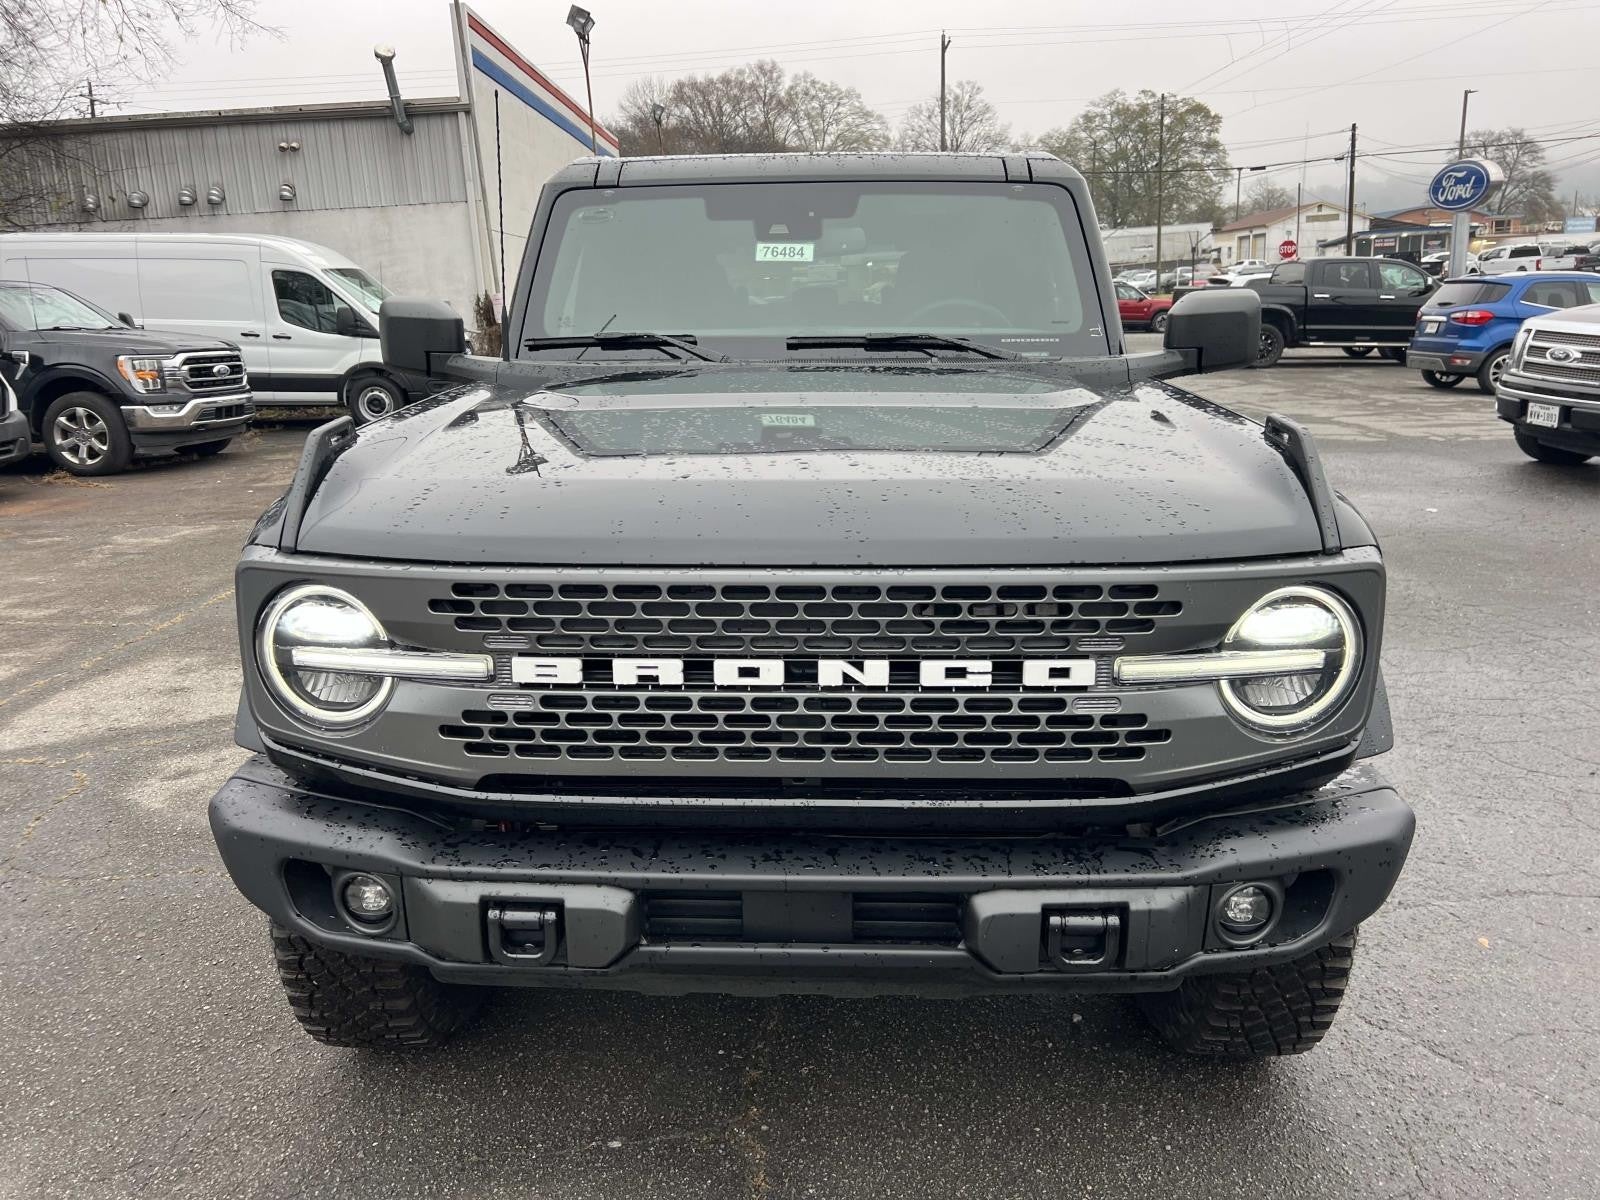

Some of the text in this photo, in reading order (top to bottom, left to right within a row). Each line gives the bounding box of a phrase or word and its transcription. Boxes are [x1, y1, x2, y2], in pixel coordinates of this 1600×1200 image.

[1438, 171, 1476, 202] Ford
[762, 246, 805, 258] 76484
[1280, 245, 1297, 254] STOP
[511, 656, 1096, 687] BRONCO
